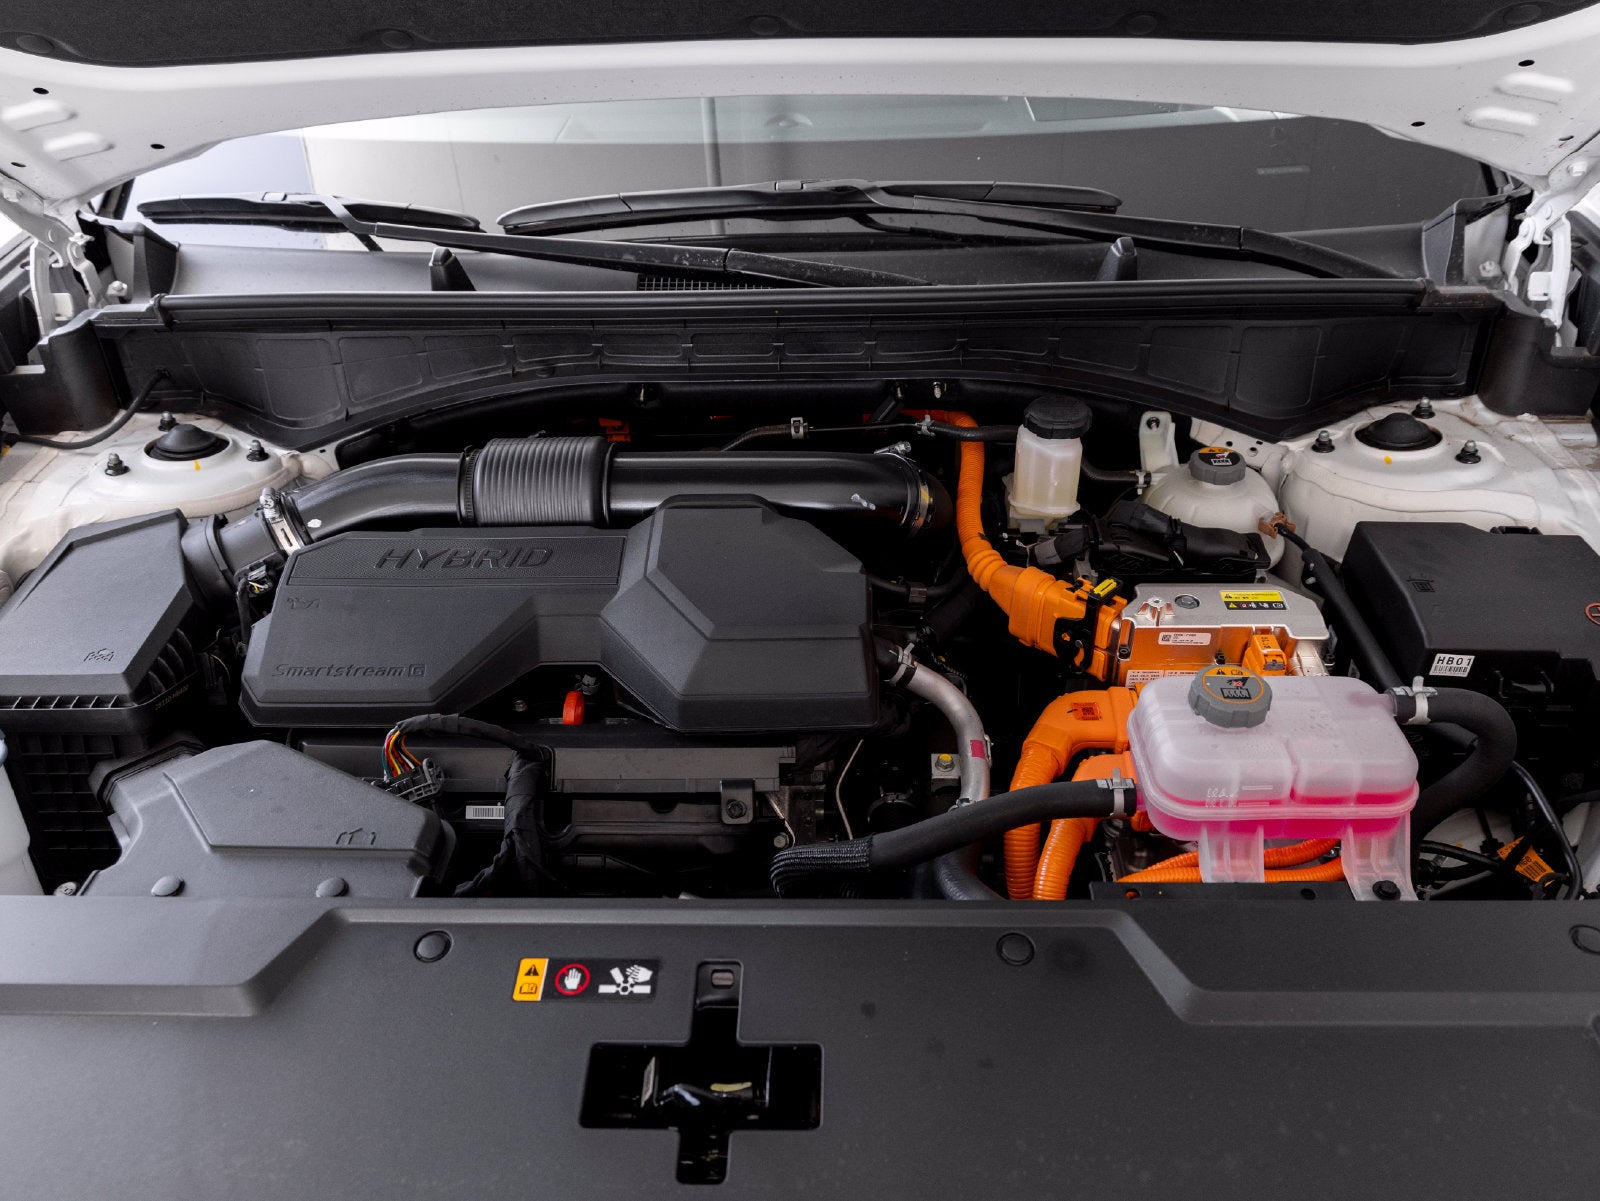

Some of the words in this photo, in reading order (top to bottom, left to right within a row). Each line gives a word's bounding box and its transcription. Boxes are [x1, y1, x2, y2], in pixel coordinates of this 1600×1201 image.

[373, 547, 553, 569] HYBRID
[1436, 656, 1471, 667] HB01
[272, 663, 405, 678] Smartstream
